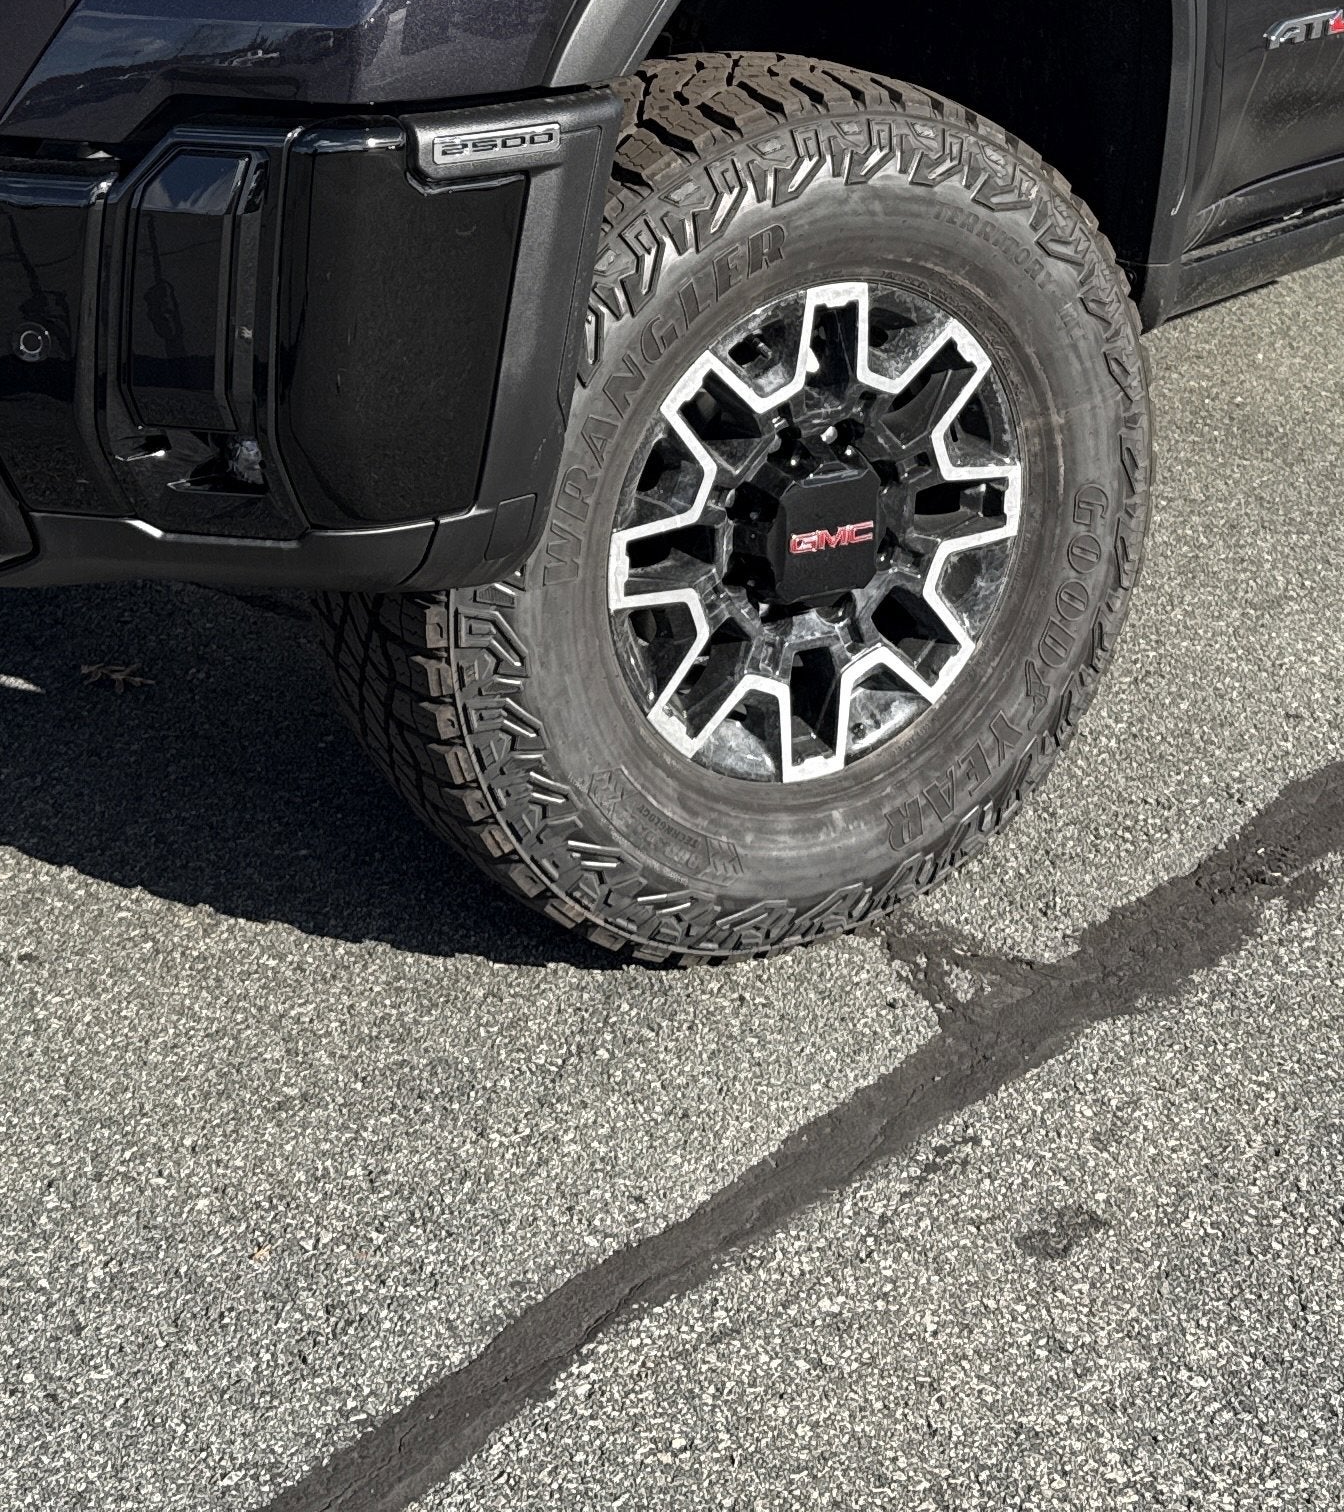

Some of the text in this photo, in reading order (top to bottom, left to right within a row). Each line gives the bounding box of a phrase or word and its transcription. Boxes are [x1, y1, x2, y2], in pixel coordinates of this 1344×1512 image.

[441, 133, 553, 156] 2500
[932, 199, 1056, 290] TERRITORY
[542, 223, 787, 587] WRANGLER
[790, 520, 873, 554] GMC
[638, 804, 699, 849] TECHNOLOGY
